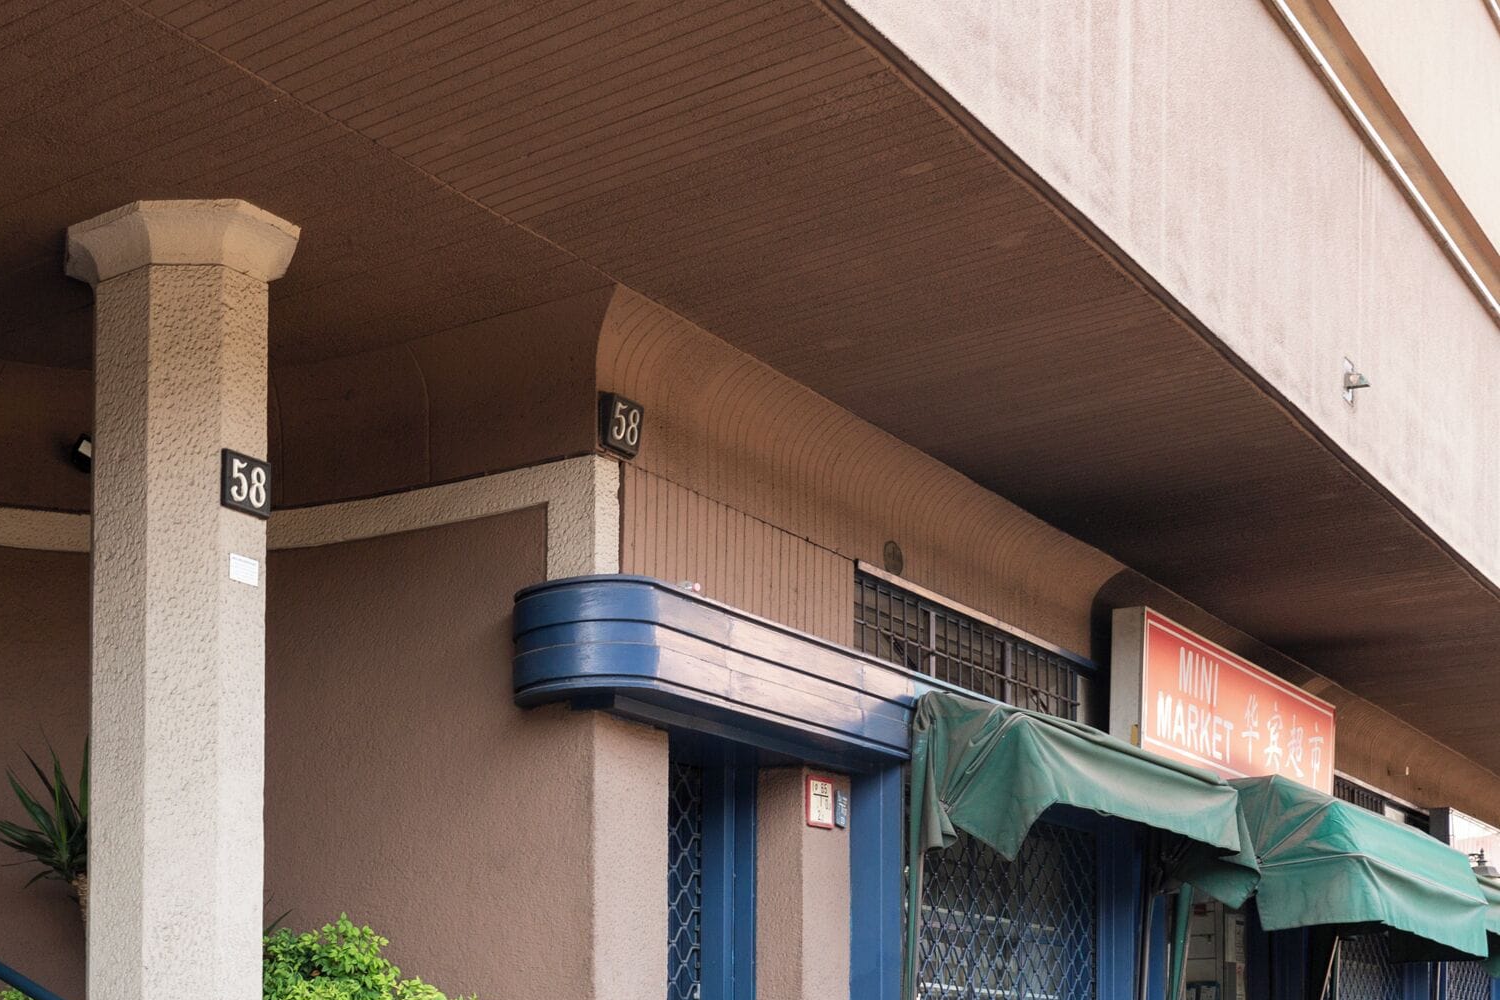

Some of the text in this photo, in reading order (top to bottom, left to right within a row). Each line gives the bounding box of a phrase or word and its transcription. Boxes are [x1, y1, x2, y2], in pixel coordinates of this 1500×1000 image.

[612, 401, 641, 446] 58
[230, 457, 267, 509] 58
[1178, 646, 1220, 706] MINI
[1156, 689, 1234, 764] MARKET
